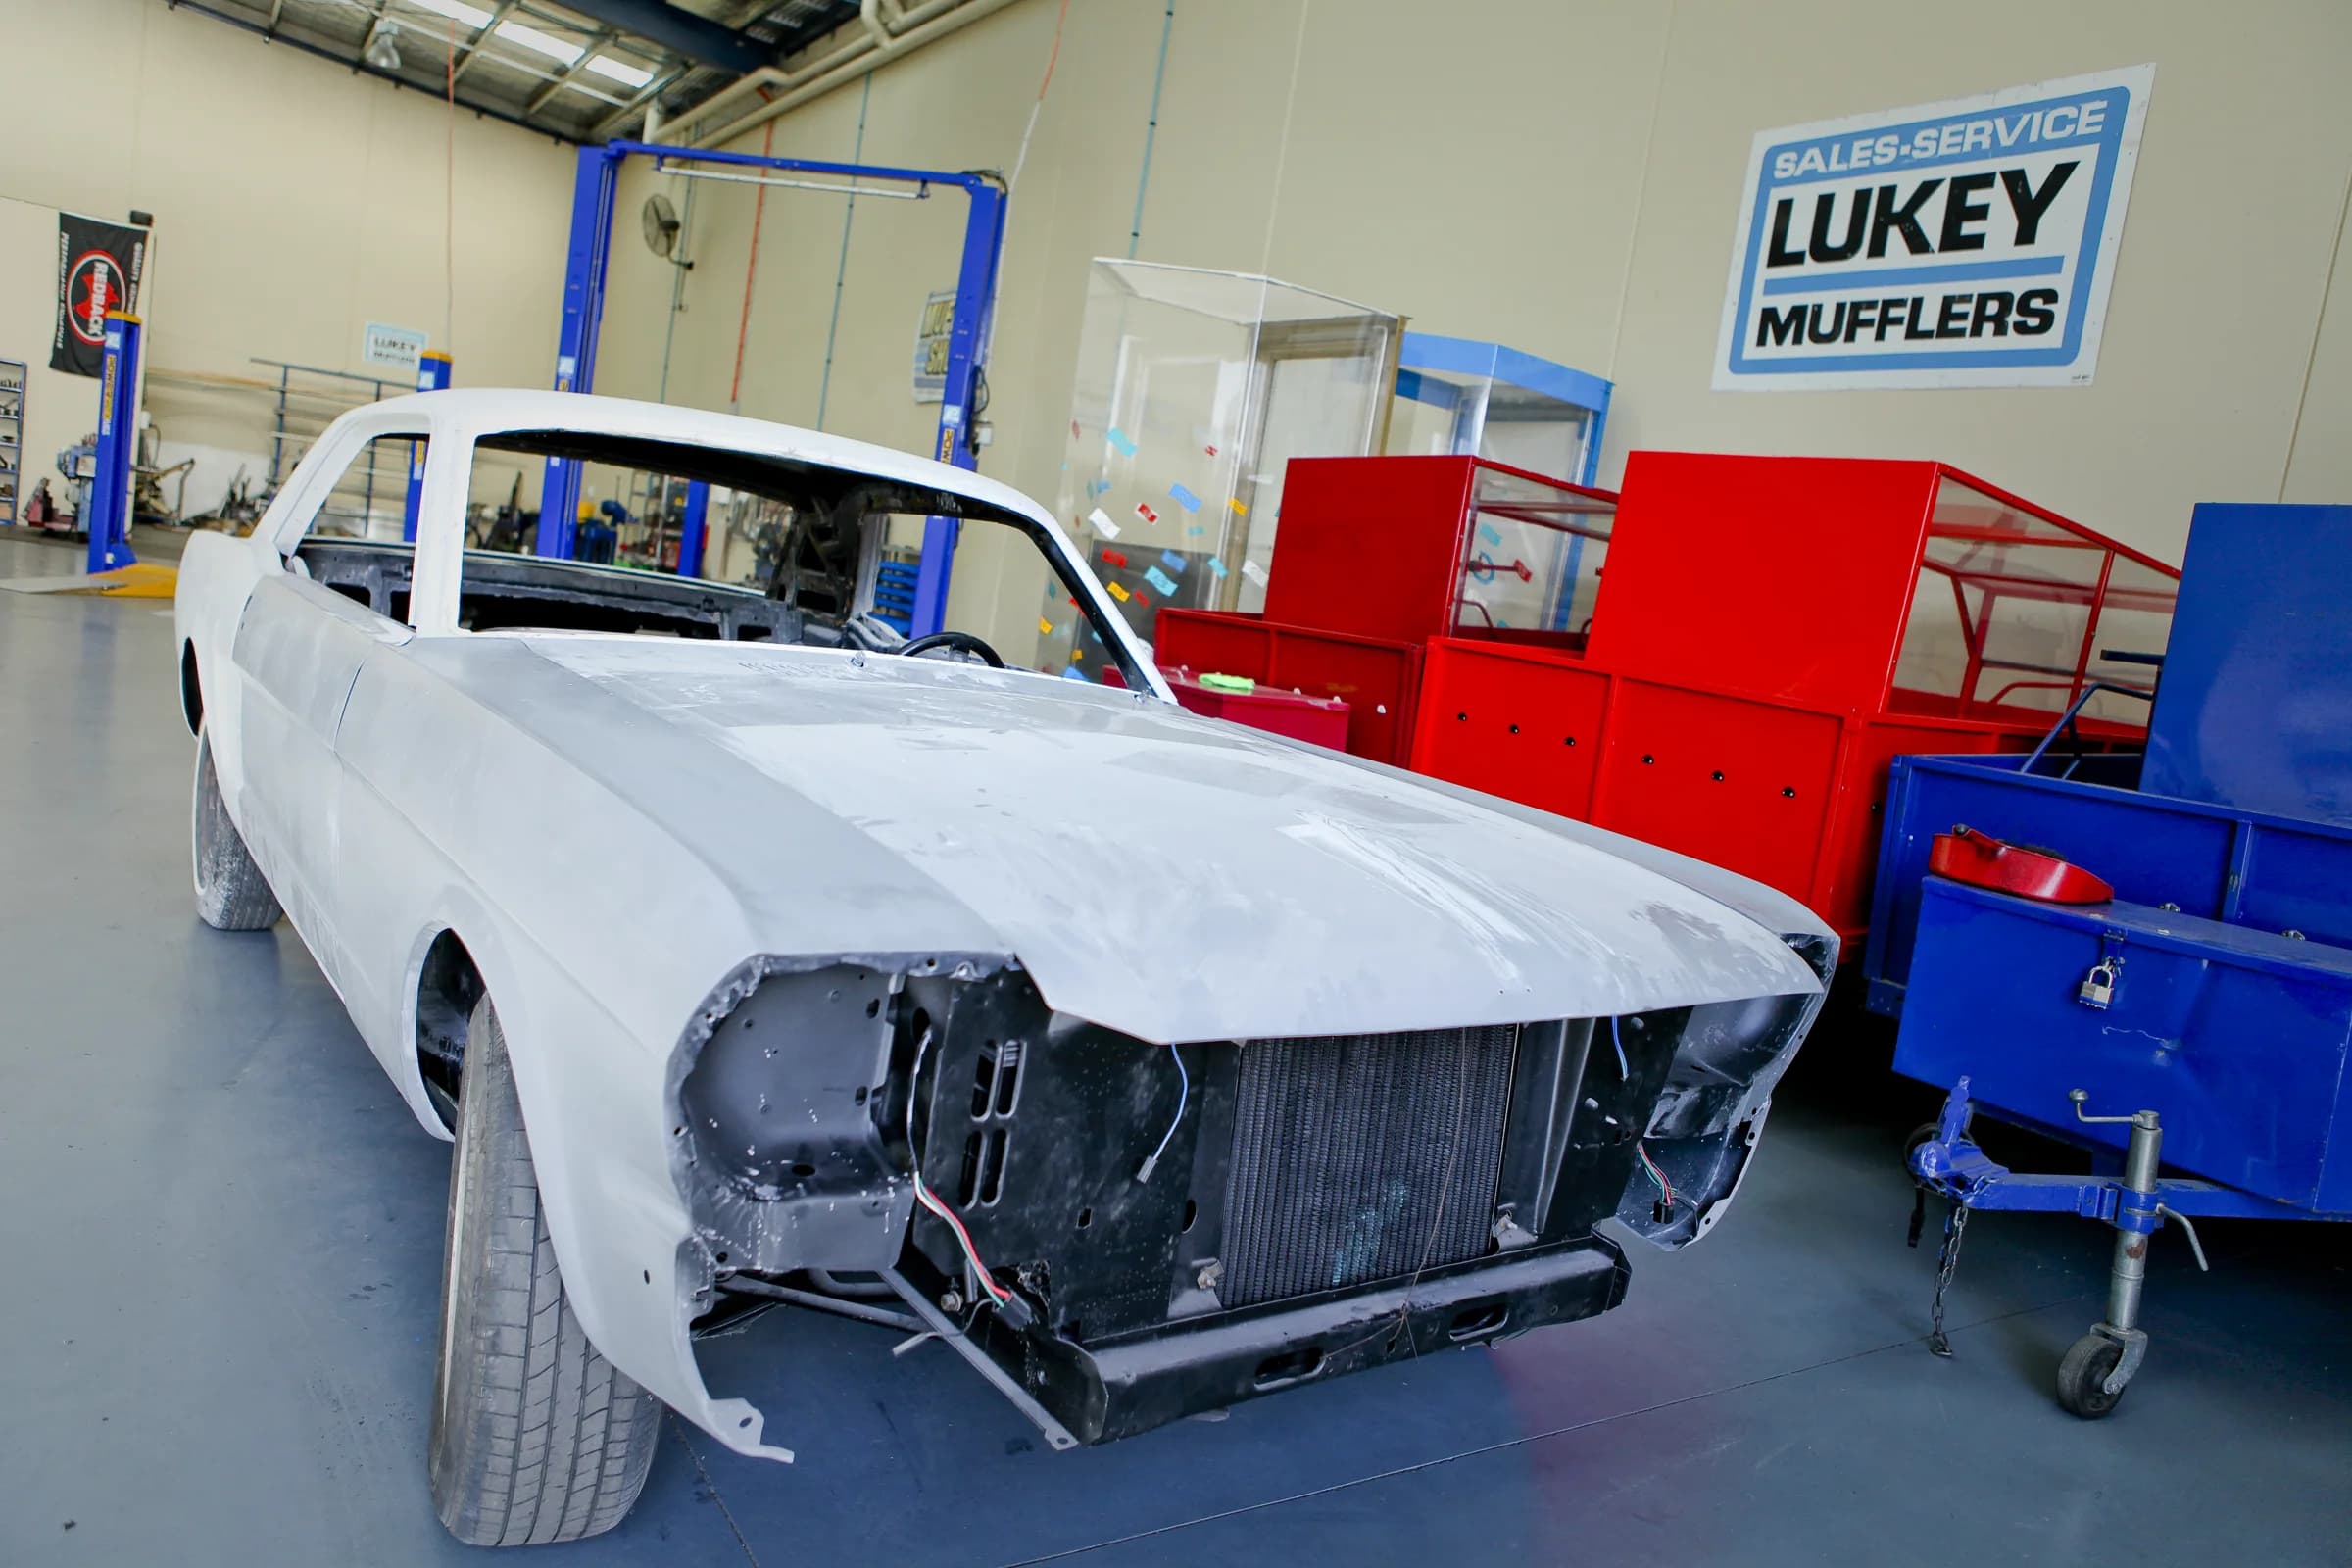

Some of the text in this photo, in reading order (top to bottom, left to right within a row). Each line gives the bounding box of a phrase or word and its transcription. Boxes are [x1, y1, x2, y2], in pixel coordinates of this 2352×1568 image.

[1773, 100, 2108, 179] SALES-SERVICE
[1766, 160, 2081, 268] LUKEY
[88, 261, 109, 337] REDBACK
[1756, 288, 2059, 347] MUFFLERS
